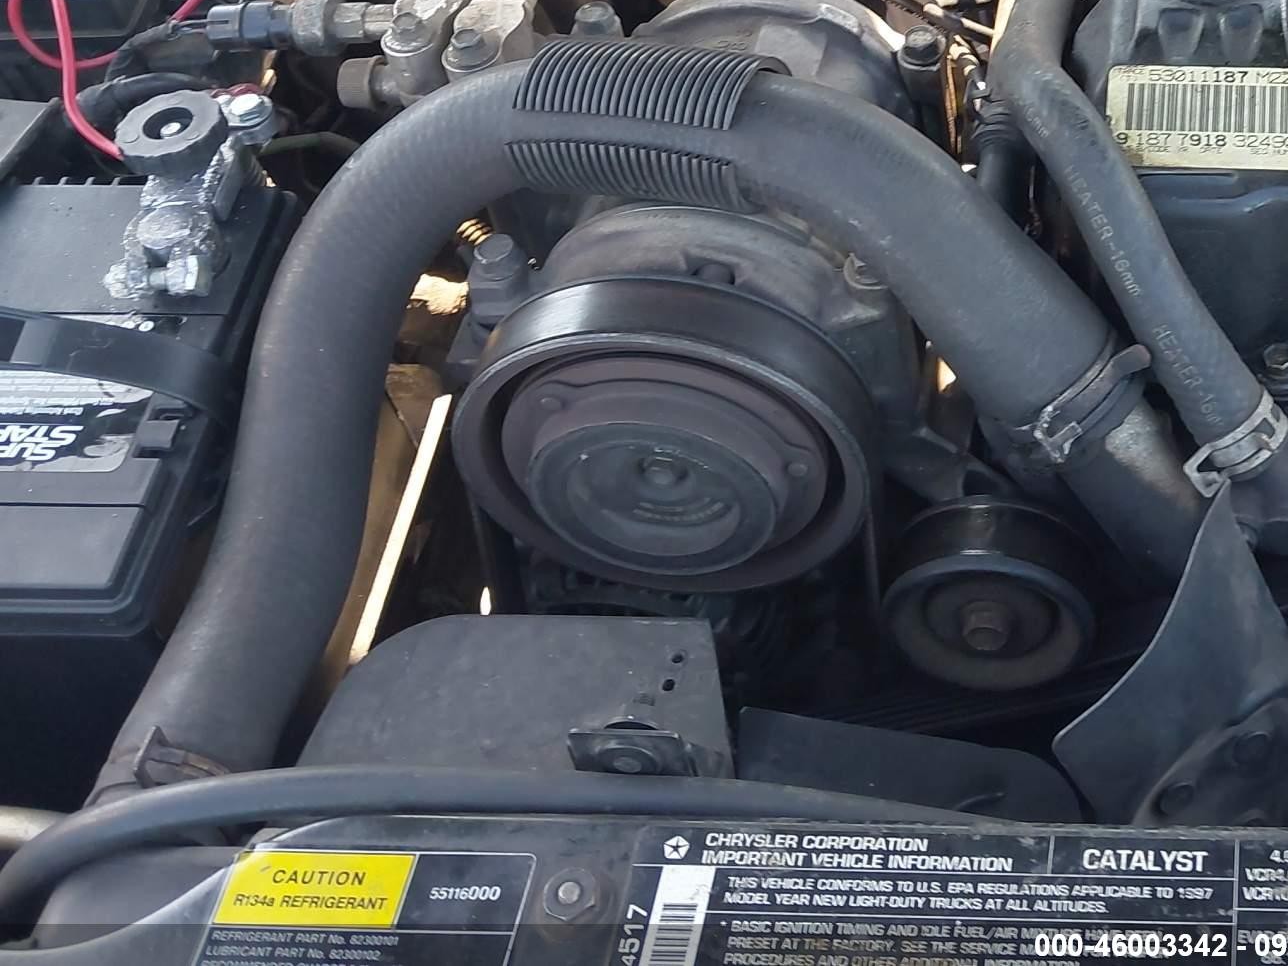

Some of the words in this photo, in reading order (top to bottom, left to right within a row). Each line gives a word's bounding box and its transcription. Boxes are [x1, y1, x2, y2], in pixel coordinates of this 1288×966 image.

[1149, 69, 1248, 84] 53011187
[705, 832, 798, 849] CHRYSLER
[802, 834, 929, 852] CORPORATION
[701, 850, 807, 866] IMPORTANT
[811, 852, 883, 869] VEHICLE
[887, 854, 1014, 872] INFORMATION
[1081, 847, 1209, 873] CATALYST
[271, 869, 367, 886] CAUTION
[430, 885, 502, 902] 55116000
[727, 876, 758, 889] THIS
[762, 877, 816, 891] VEHICLE
[816, 879, 893, 893] CONFORMS
[895, 880, 916, 892] TO
[916, 880, 943, 894] U.S.
[947, 882, 976, 895] EPA
[977, 883, 1070, 897] REGULATIONS
[1071, 885, 1152, 899] APPLICABLE
[1155, 887, 1174, 900] TO
[233, 894, 275, 909] R134a
[280, 895, 388, 911] REFRIGERANT
[723, 892, 770, 905] MODEL
[775, 893, 811, 906] YEAR
[812, 894, 847, 907] NEW
[849, 895, 926, 910] LIGHT-DUTY
[929, 897, 983, 911] TRUCKS
[984, 899, 1004, 912] AT
[1006, 900, 1032, 913] ALL
[1033, 901, 1109, 914] ALTITUDES.
[211, 931, 294, 944] REFRIGERANT
[294, 932, 327, 944] PART
[327, 932, 346, 945] No.
[730, 920, 772, 933] BASIC
[774, 921, 834, 934] IGNITION
[836, 922, 886, 936] TIMING
[887, 924, 919, 937] AND
[953, 925, 1018, 939] FUEL/AIR
[206, 945, 273, 959] LUBRICANT
[274, 946, 306, 959] PART
[307, 948, 326, 960] No.
[728, 936, 779, 949] PRESET
[781, 938, 801, 950] AT
[800, 938, 830, 951] THE
[832, 939, 896, 952] FACTORY.
[901, 940, 928, 953] SEE
[930, 941, 958, 954] THE
[960, 942, 1018, 955] SERVICE
[723, 952, 815, 966] PROCEDURES
[817, 955, 849, 966] AND
